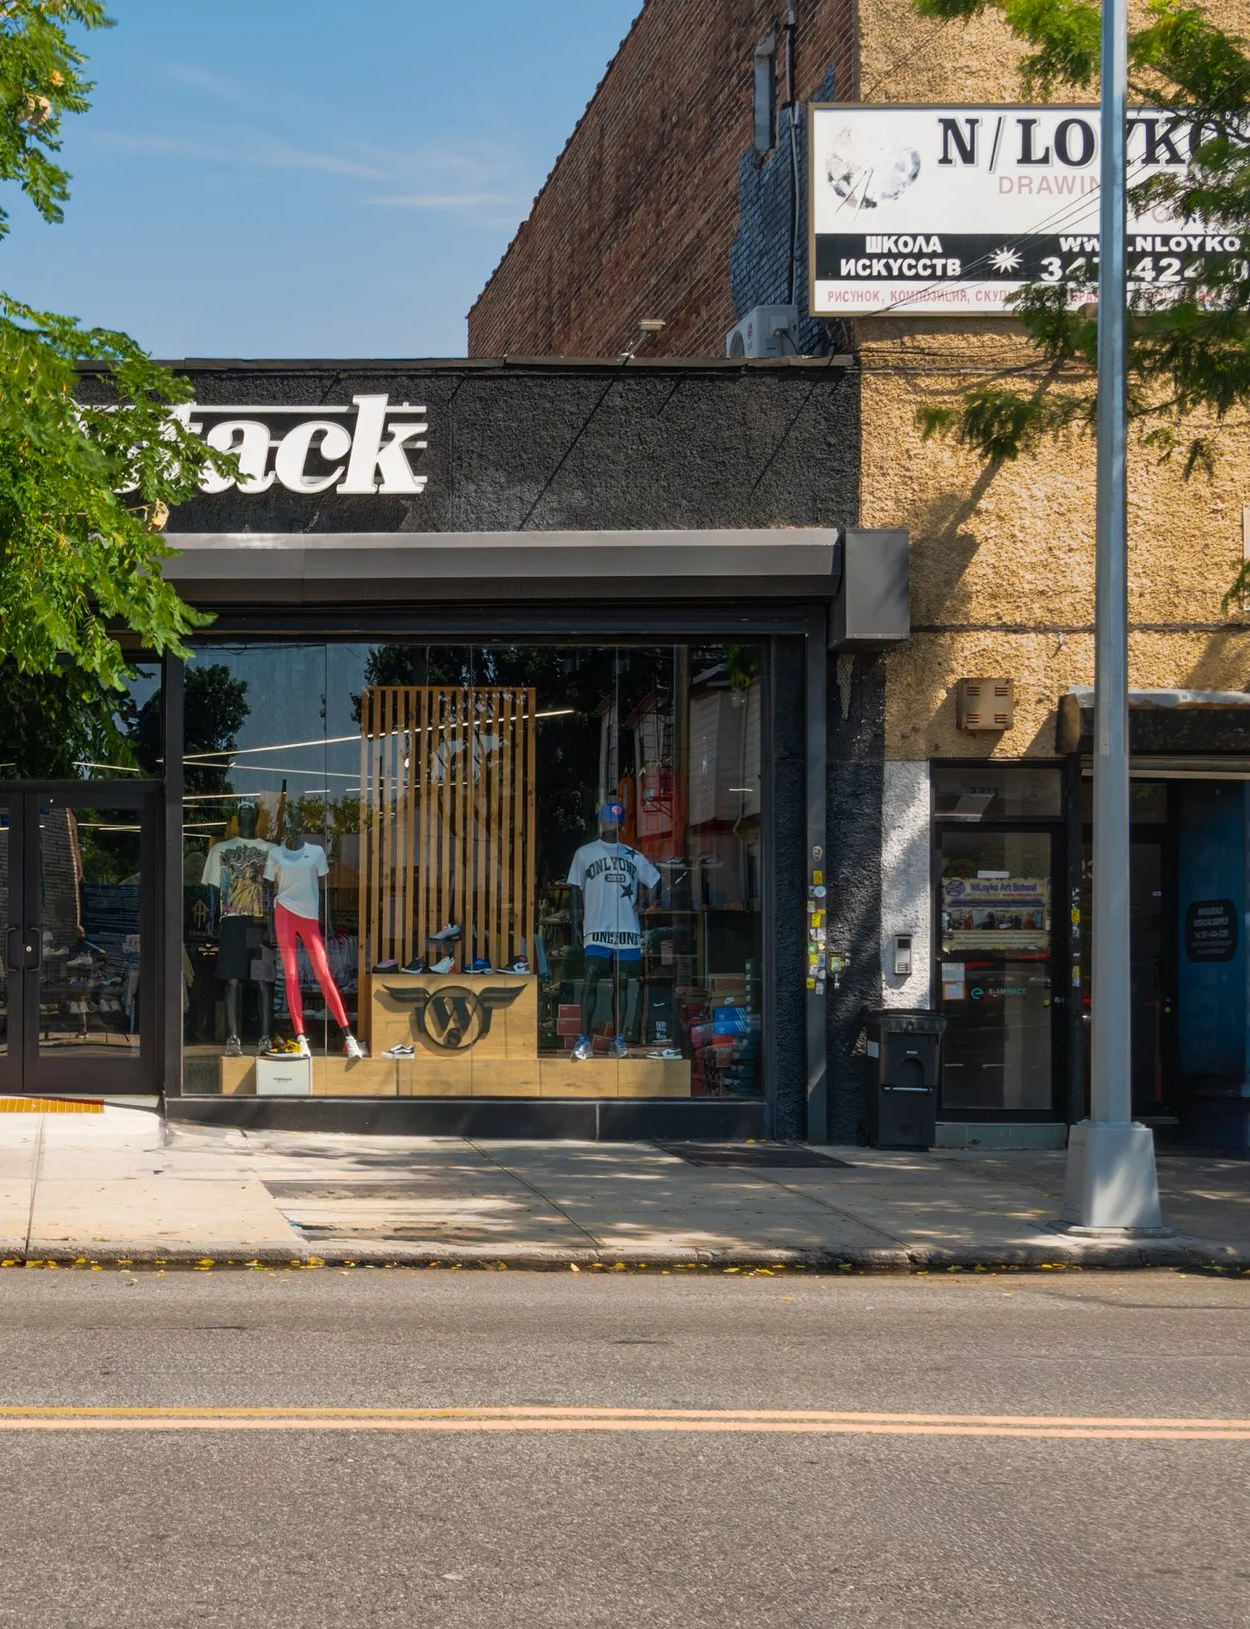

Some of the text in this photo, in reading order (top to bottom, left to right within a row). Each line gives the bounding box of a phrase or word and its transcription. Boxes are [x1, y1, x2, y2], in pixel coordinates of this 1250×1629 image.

[998, 175, 1101, 196] DRAWIN
[865, 235, 943, 254] ШКОЛА
[840, 258, 962, 277] ИСКУССТВ
